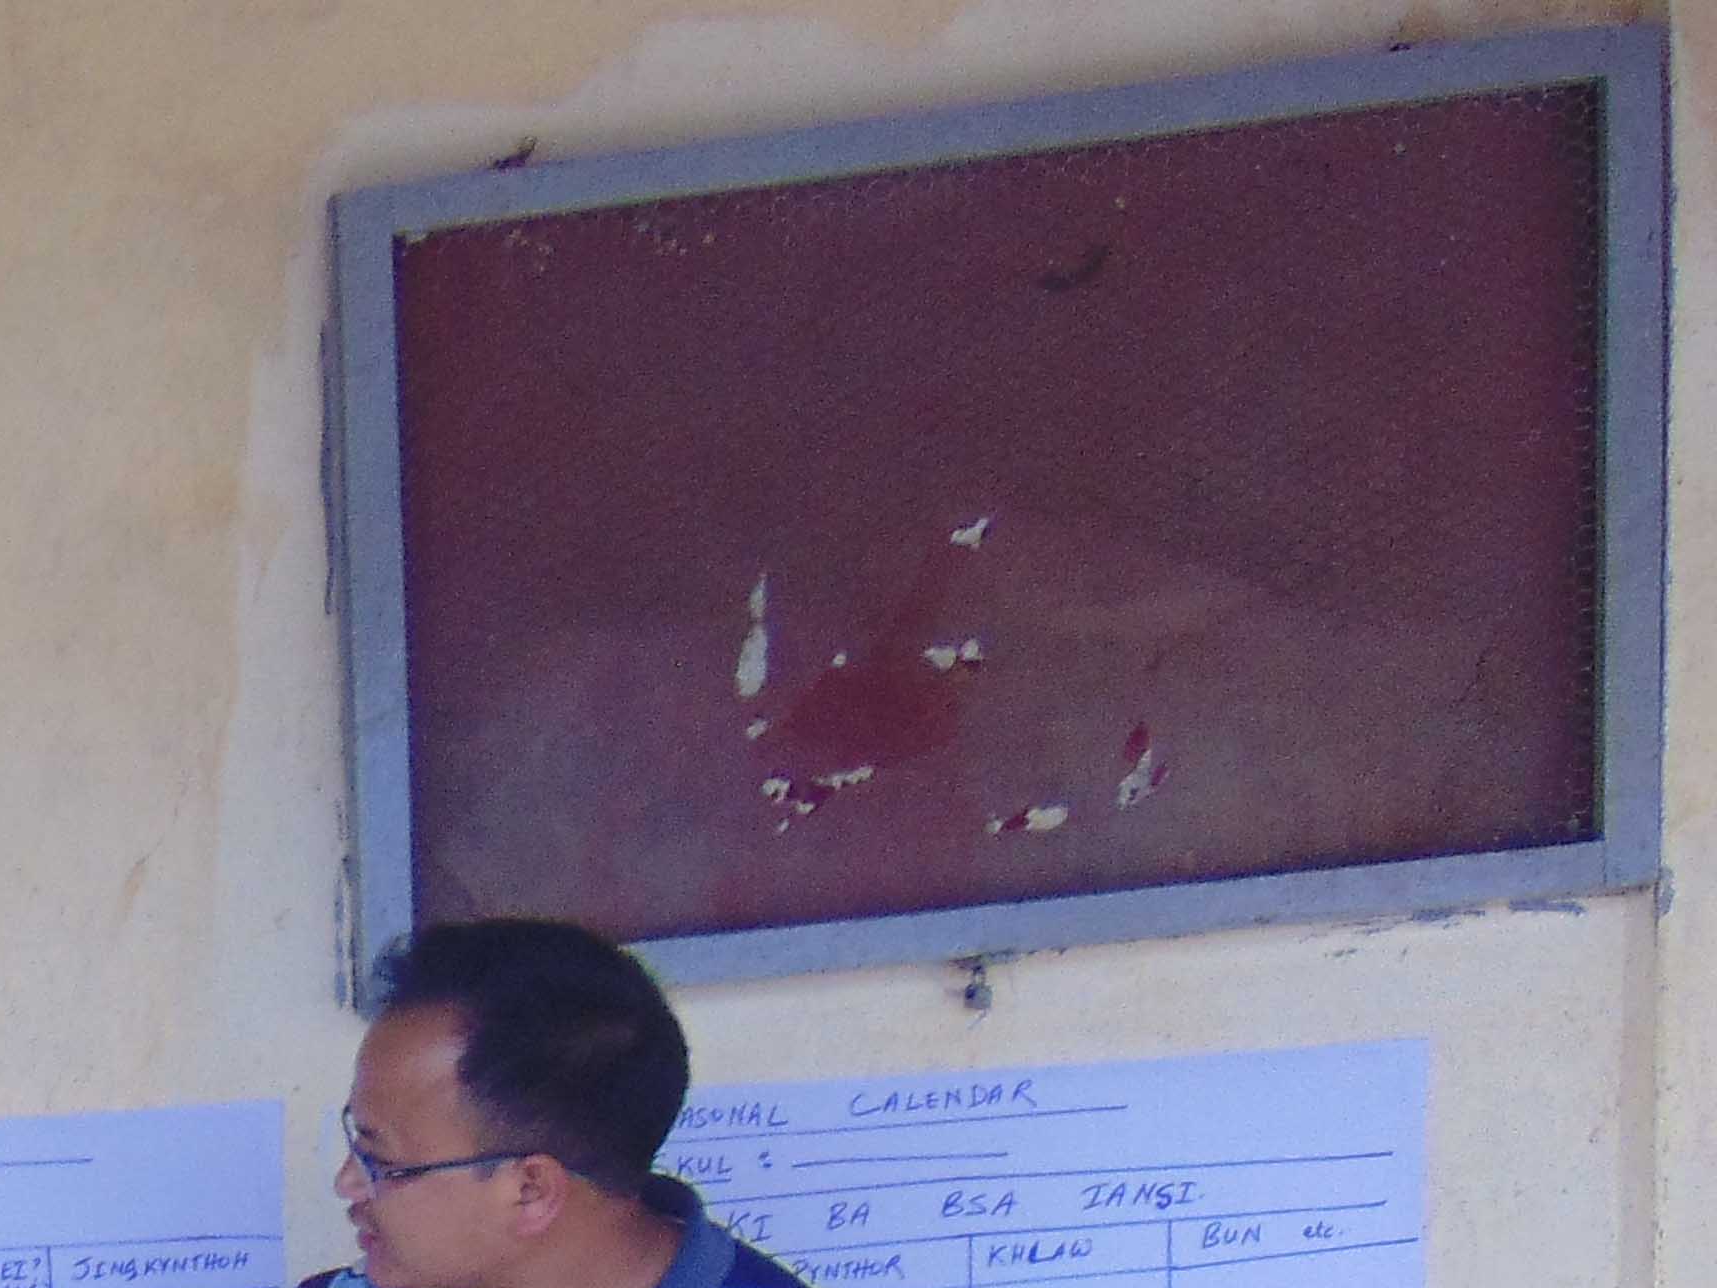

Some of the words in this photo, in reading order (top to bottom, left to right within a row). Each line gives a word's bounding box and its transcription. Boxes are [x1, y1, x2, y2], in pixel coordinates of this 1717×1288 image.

[677, 1101, 788, 1129] ASONAL
[848, 1080, 1038, 1116] CALENDAR
[826, 1203, 871, 1231] BA
[941, 1190, 1018, 1217] BSA
[987, 1238, 1093, 1268] KHLAW
[1202, 1223, 1261, 1249] BUN
